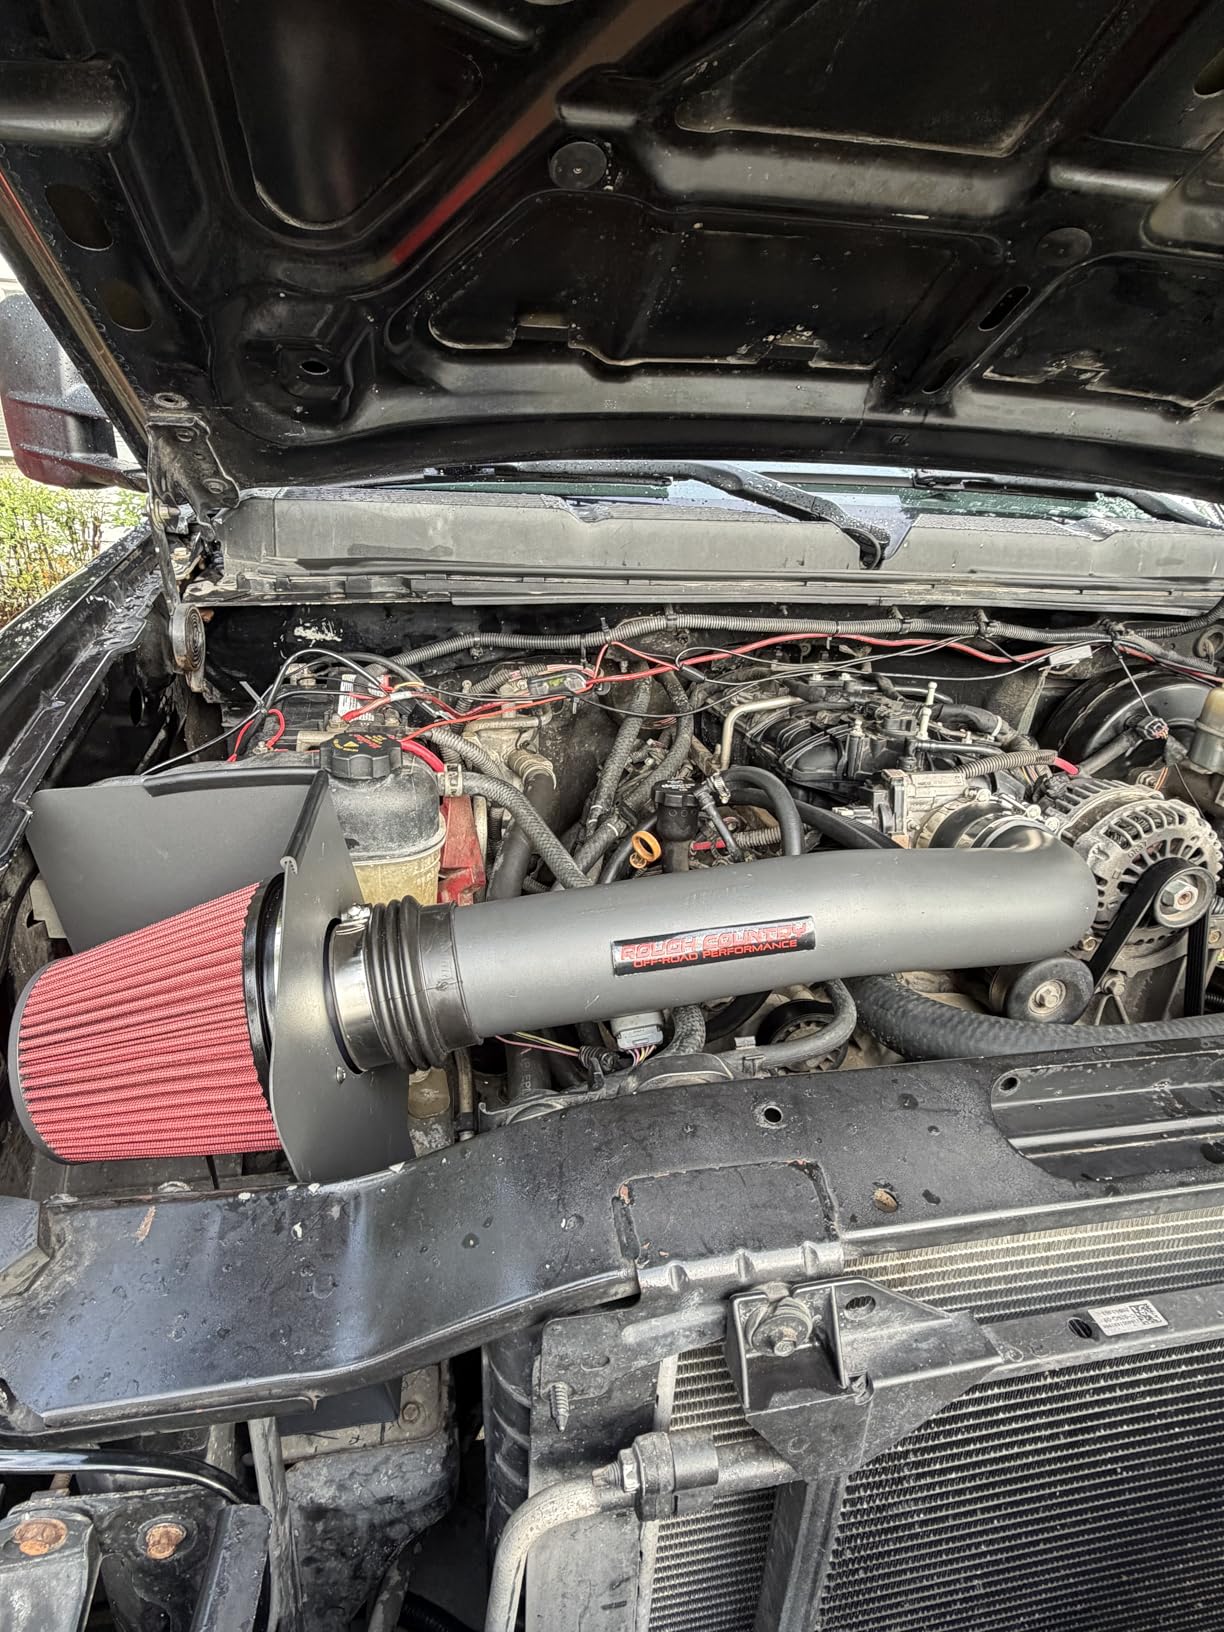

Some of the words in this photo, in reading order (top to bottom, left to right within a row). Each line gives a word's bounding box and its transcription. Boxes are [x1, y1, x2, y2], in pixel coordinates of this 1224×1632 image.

[620, 936, 696, 960] ROUGH
[702, 922, 807, 949] COUNTRY
[632, 952, 698, 969] OFF-ROAD
[702, 940, 798, 960] PERFORMANCE
